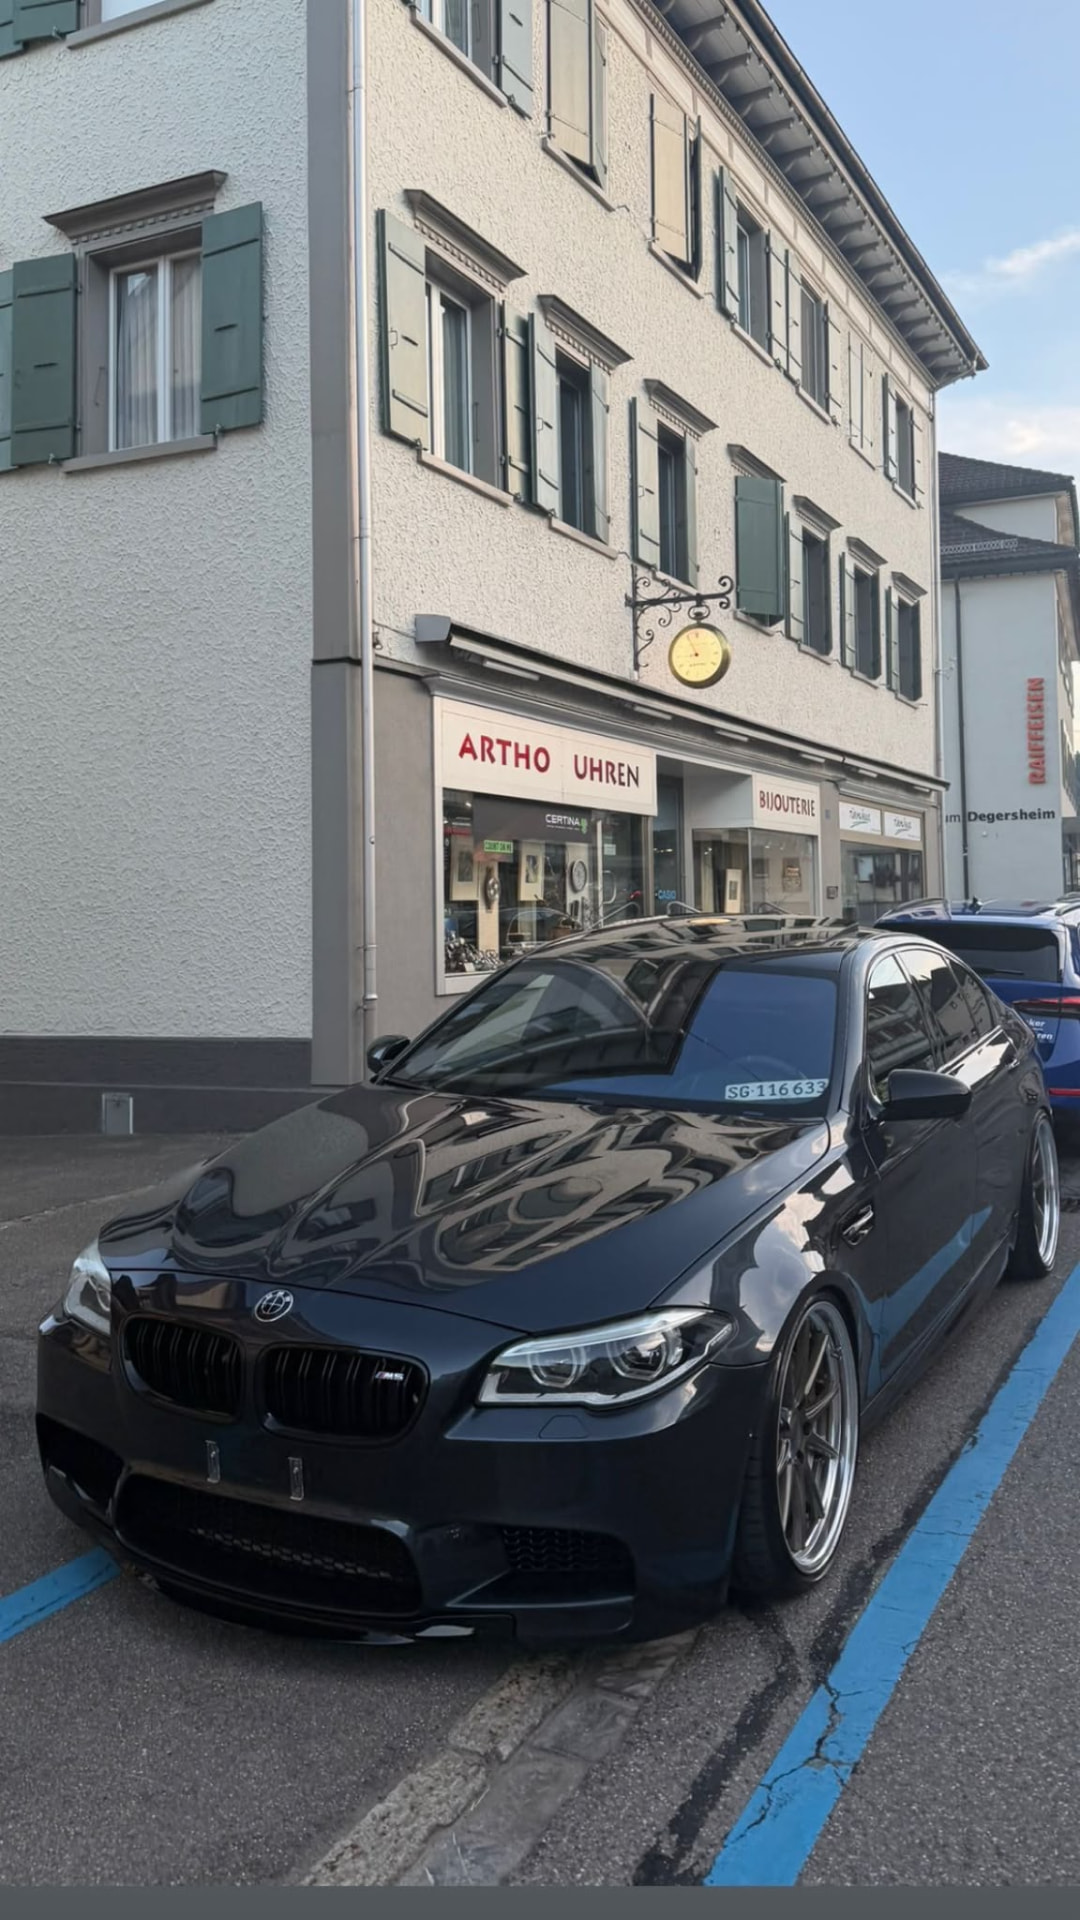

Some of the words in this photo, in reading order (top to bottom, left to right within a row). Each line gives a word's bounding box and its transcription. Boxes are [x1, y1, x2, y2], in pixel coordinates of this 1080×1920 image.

[1027, 677, 1046, 785] RAIFFEISEN
[458, 732, 551, 773] ARTHO
[573, 754, 640, 789] UHREN
[759, 790, 816, 817] BIJOUTERIE
[967, 808, 1056, 824] Degersheim
[545, 813, 581, 827] CERTINA
